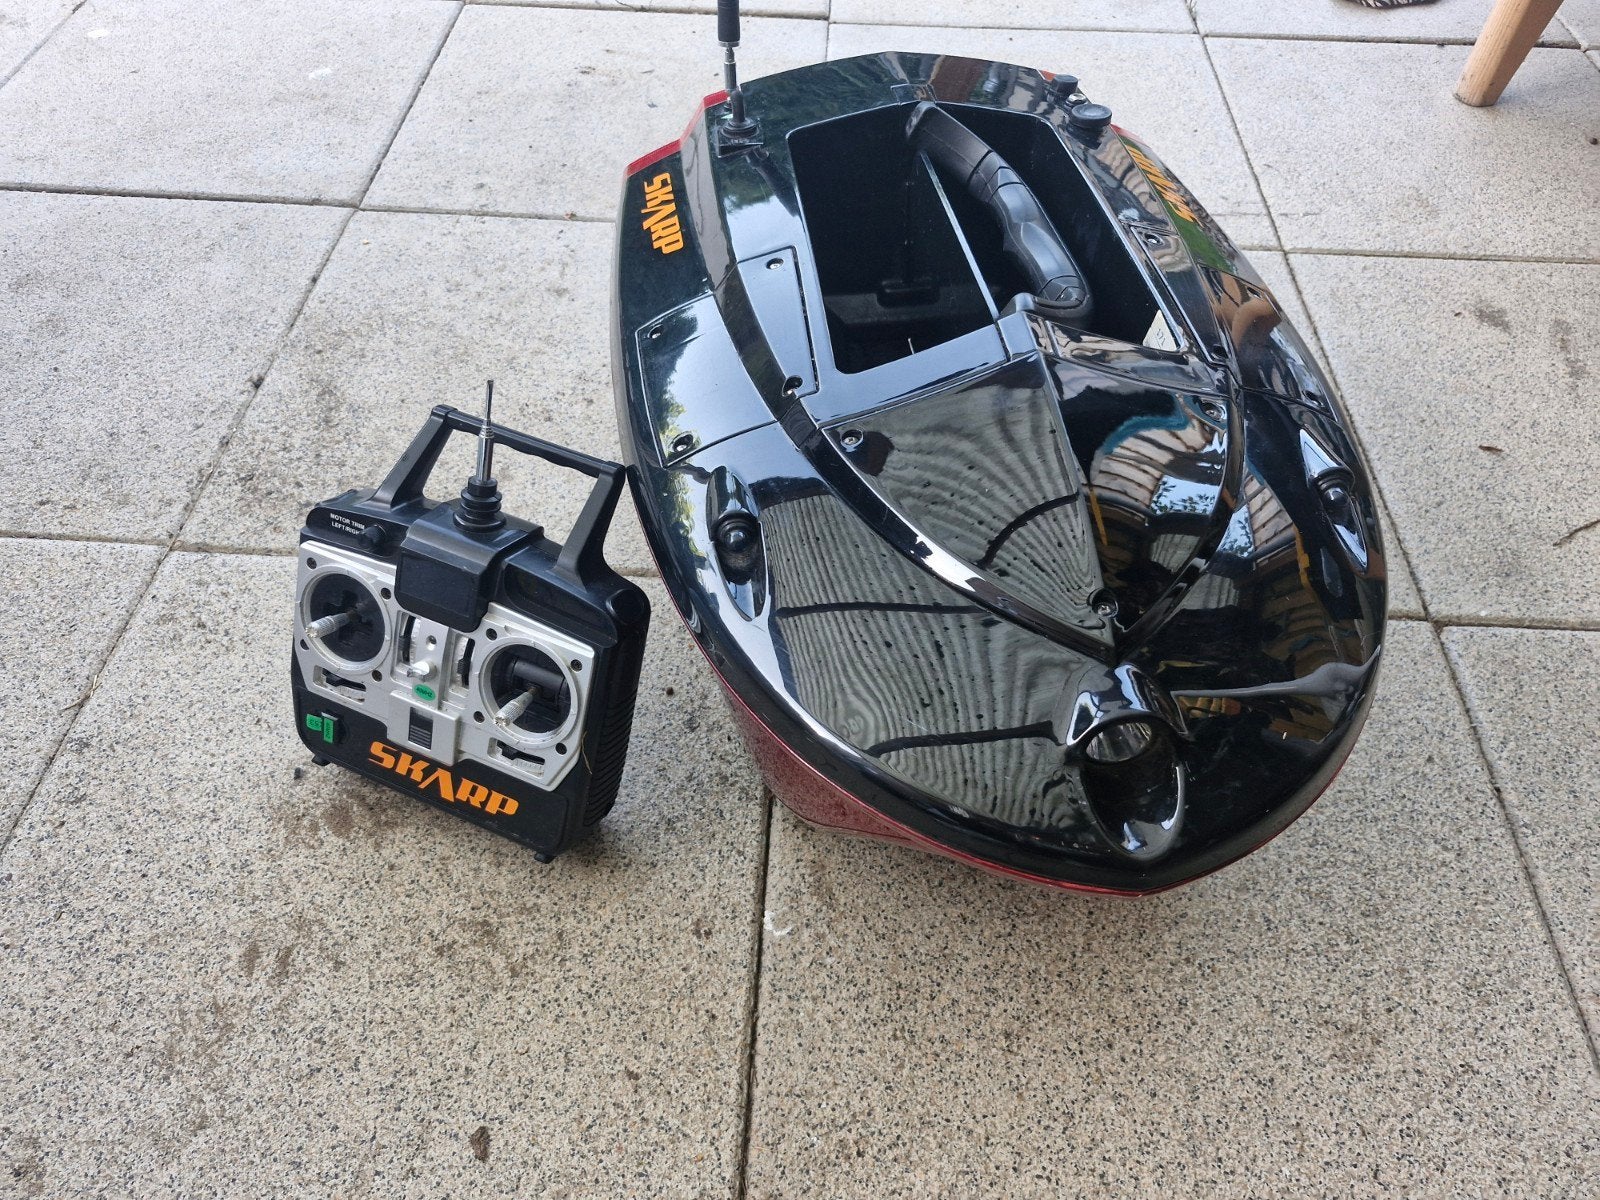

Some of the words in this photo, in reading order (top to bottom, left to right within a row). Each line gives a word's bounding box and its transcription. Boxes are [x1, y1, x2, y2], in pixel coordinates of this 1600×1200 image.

[641, 172, 684, 255] SKARP
[330, 512, 351, 524] MOTOR
[351, 520, 366, 530] TRIM
[331, 521, 363, 535] LEFT/RIGH
[368, 741, 519, 816] SKARP
